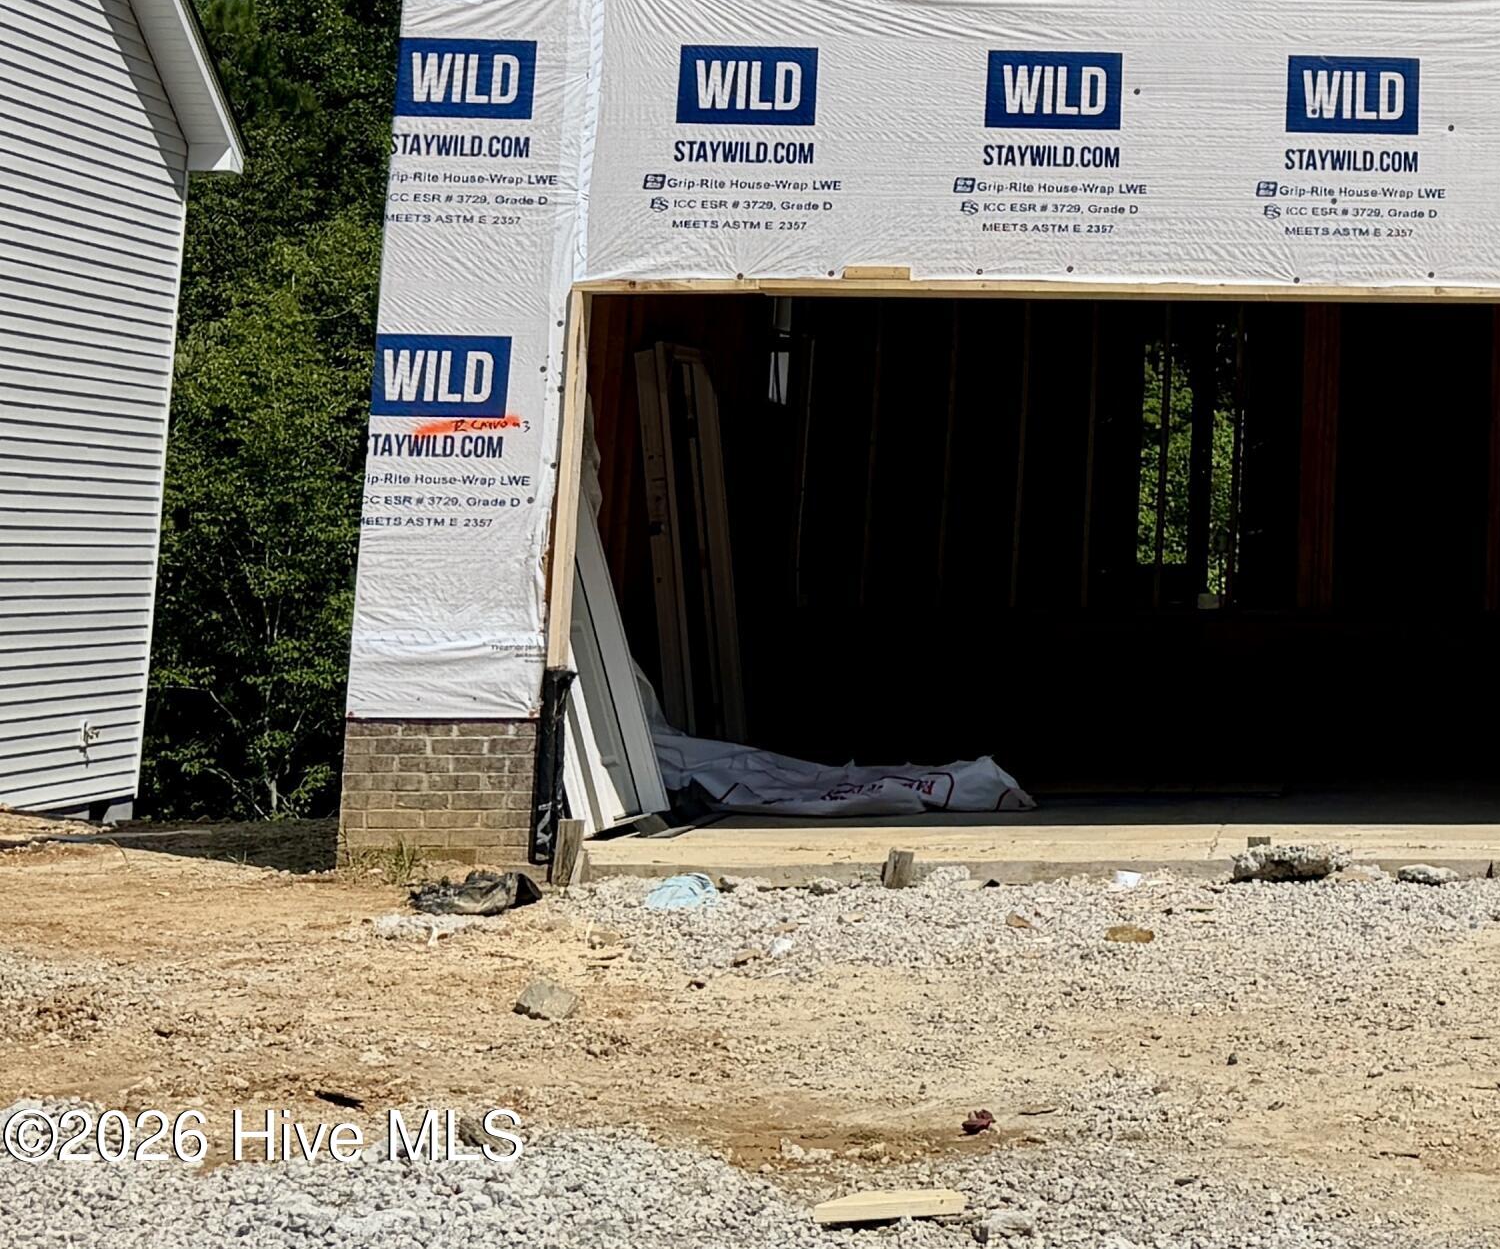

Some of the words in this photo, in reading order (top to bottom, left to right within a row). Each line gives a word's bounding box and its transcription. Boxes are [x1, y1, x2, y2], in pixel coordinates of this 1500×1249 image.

[410, 52, 519, 104] WILD
[695, 59, 801, 111] WILD
[1002, 65, 1106, 115] WILD
[1303, 70, 1404, 120] WILD
[674, 141, 814, 164] STAYWILD.COM
[983, 145, 1120, 168] STAYWILD.COM
[1284, 149, 1418, 173] STAYWILD.COM
[668, 177, 725, 189] Grip-Rite
[730, 179, 808, 192] House-Wrap
[813, 180, 841, 190] LWE
[674, 199, 696, 209] ICC
[701, 200, 727, 209] ESR
[781, 201, 819, 211] Grade
[823, 202, 832, 210] D
[672, 219, 718, 229] MEETS
[723, 220, 760, 229] ASTM
[765, 221, 773, 229] E
[382, 349, 492, 403] WILD
[364, 434, 503, 459] TAYWILD.COM
